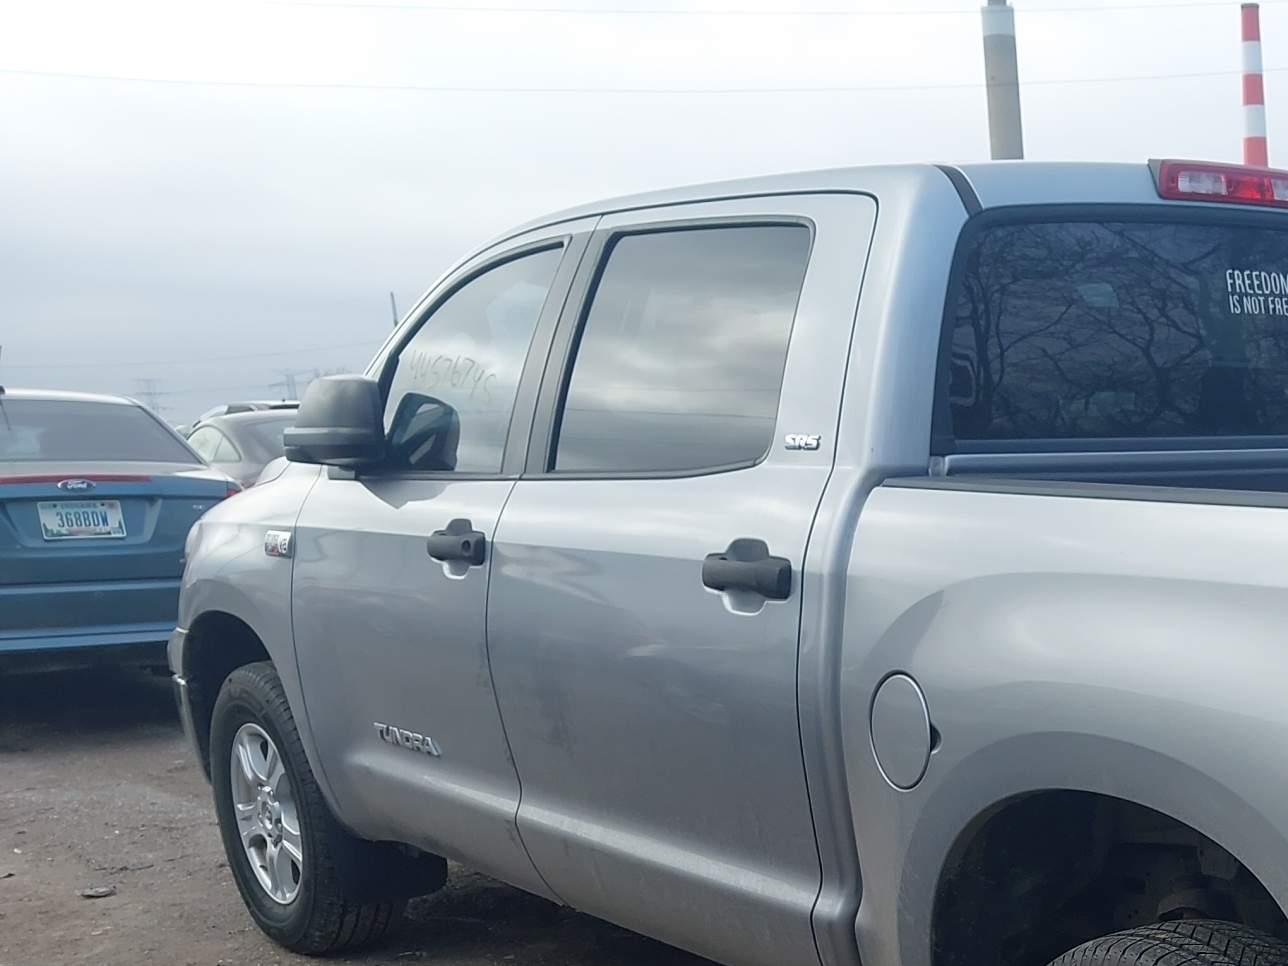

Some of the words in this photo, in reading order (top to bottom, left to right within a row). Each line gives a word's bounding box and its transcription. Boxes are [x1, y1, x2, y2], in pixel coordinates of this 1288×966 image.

[1228, 294, 1241, 314] IS
[1243, 295, 1265, 314] NOT
[373, 722, 442, 757] TUNDRA
